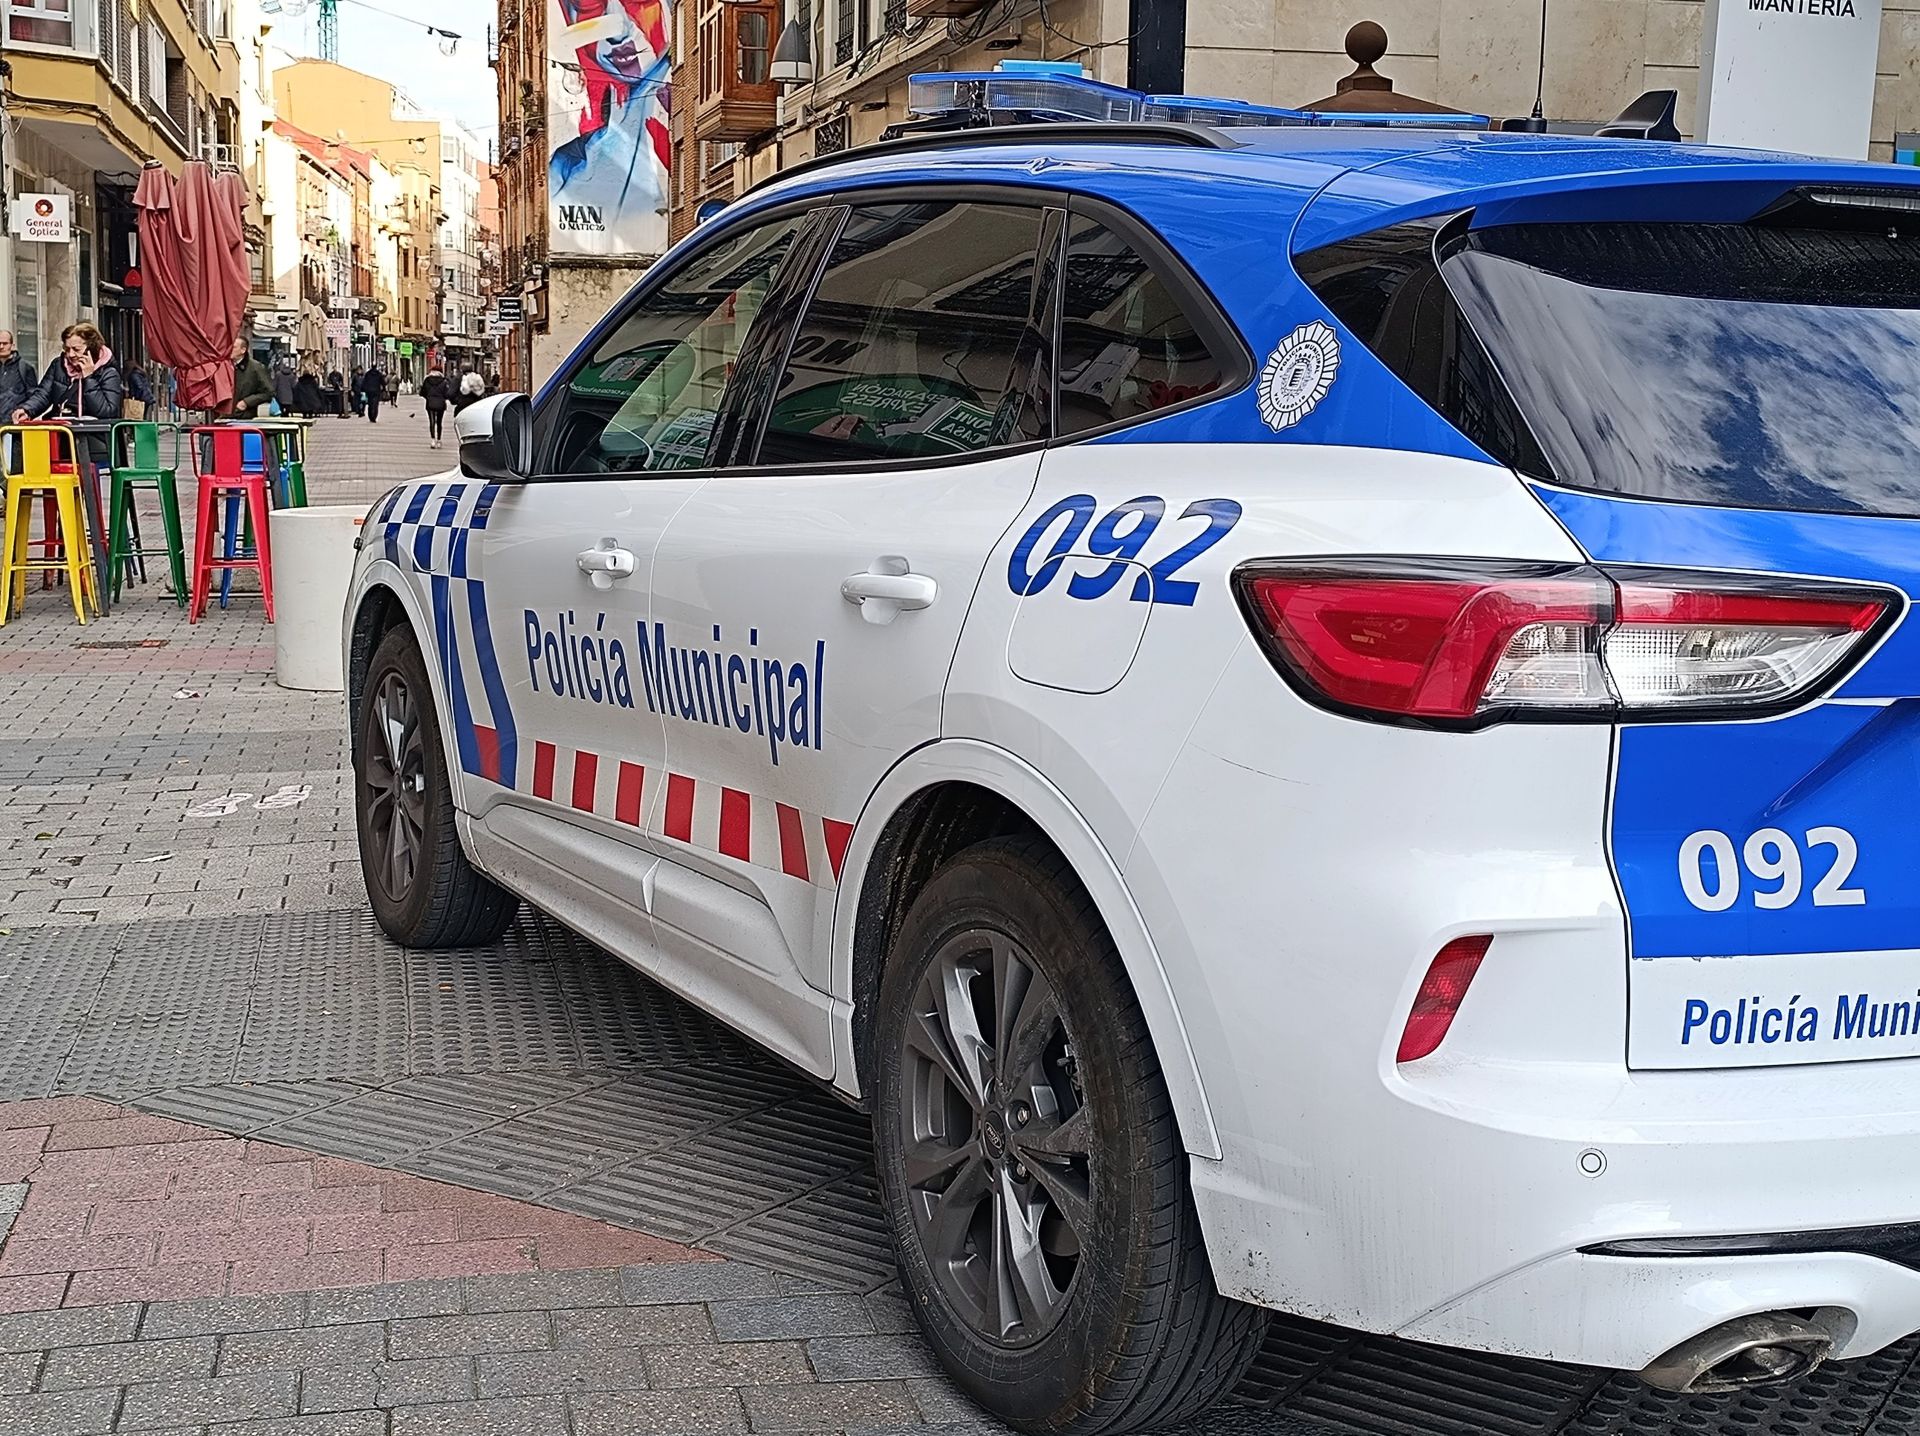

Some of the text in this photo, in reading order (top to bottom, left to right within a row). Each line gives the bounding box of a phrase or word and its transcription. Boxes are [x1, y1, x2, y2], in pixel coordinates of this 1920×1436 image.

[26, 218, 63, 228] General
[29, 227, 60, 237] Optica
[559, 205, 602, 224] MAN
[1007, 494, 1243, 607] 092
[524, 608, 826, 767] Policía Municipal
[1678, 826, 1866, 911] 092
[1681, 994, 1819, 1045] Policía
